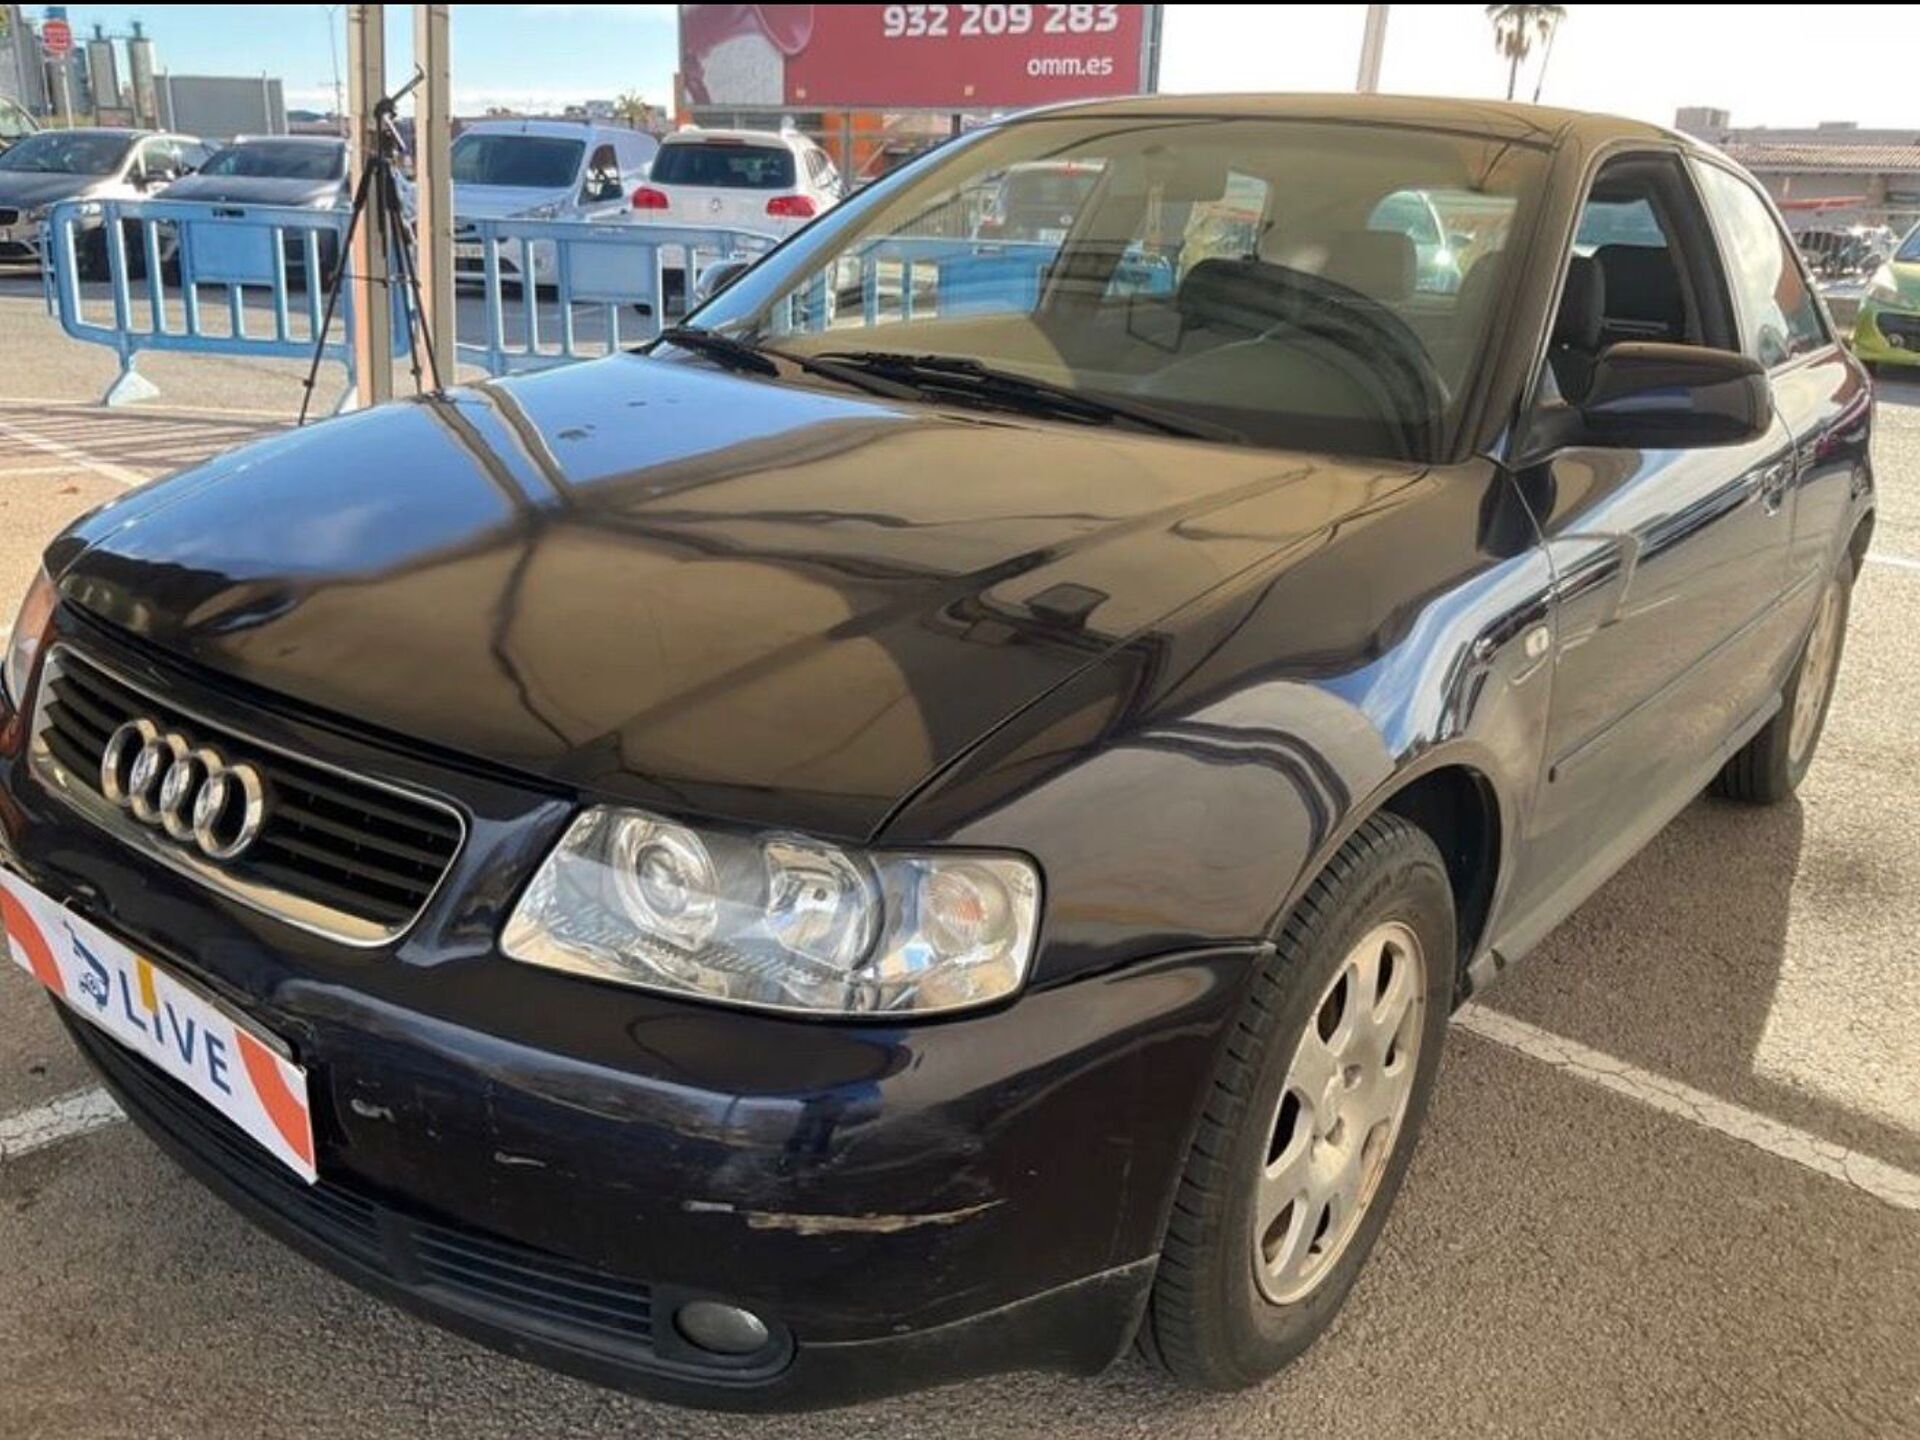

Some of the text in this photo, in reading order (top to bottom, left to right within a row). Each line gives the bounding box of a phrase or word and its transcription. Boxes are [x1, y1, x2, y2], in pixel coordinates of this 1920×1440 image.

[884, 4, 1118, 37] 932 209 283
[1027, 56, 1113, 76] omm.es
[118, 969, 232, 1096] LIVE
